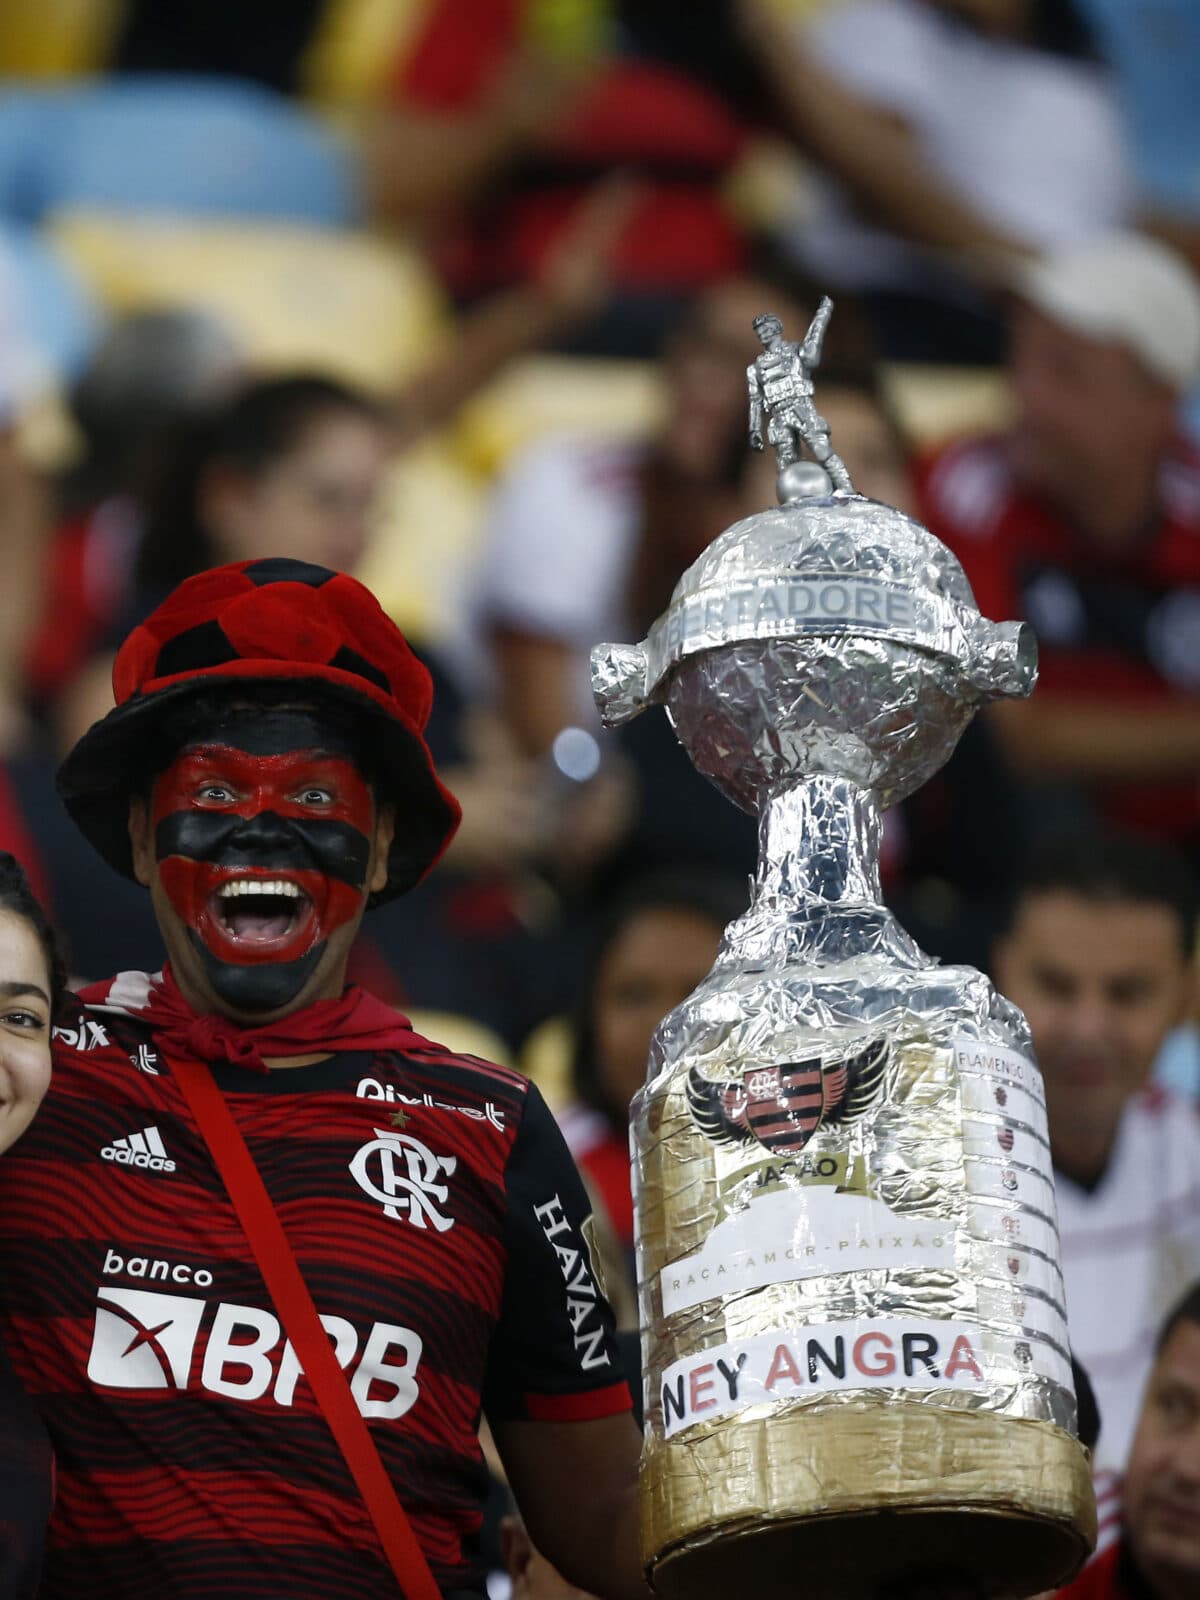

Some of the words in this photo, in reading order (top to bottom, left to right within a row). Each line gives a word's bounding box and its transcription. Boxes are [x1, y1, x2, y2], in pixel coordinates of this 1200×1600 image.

[100, 1144, 177, 1174] adidas
[102, 1249, 214, 1288] banco
[532, 1193, 611, 1371] HAVAN
[663, 1353, 747, 1430] NEY
[764, 1331, 984, 1393] ANGRA
